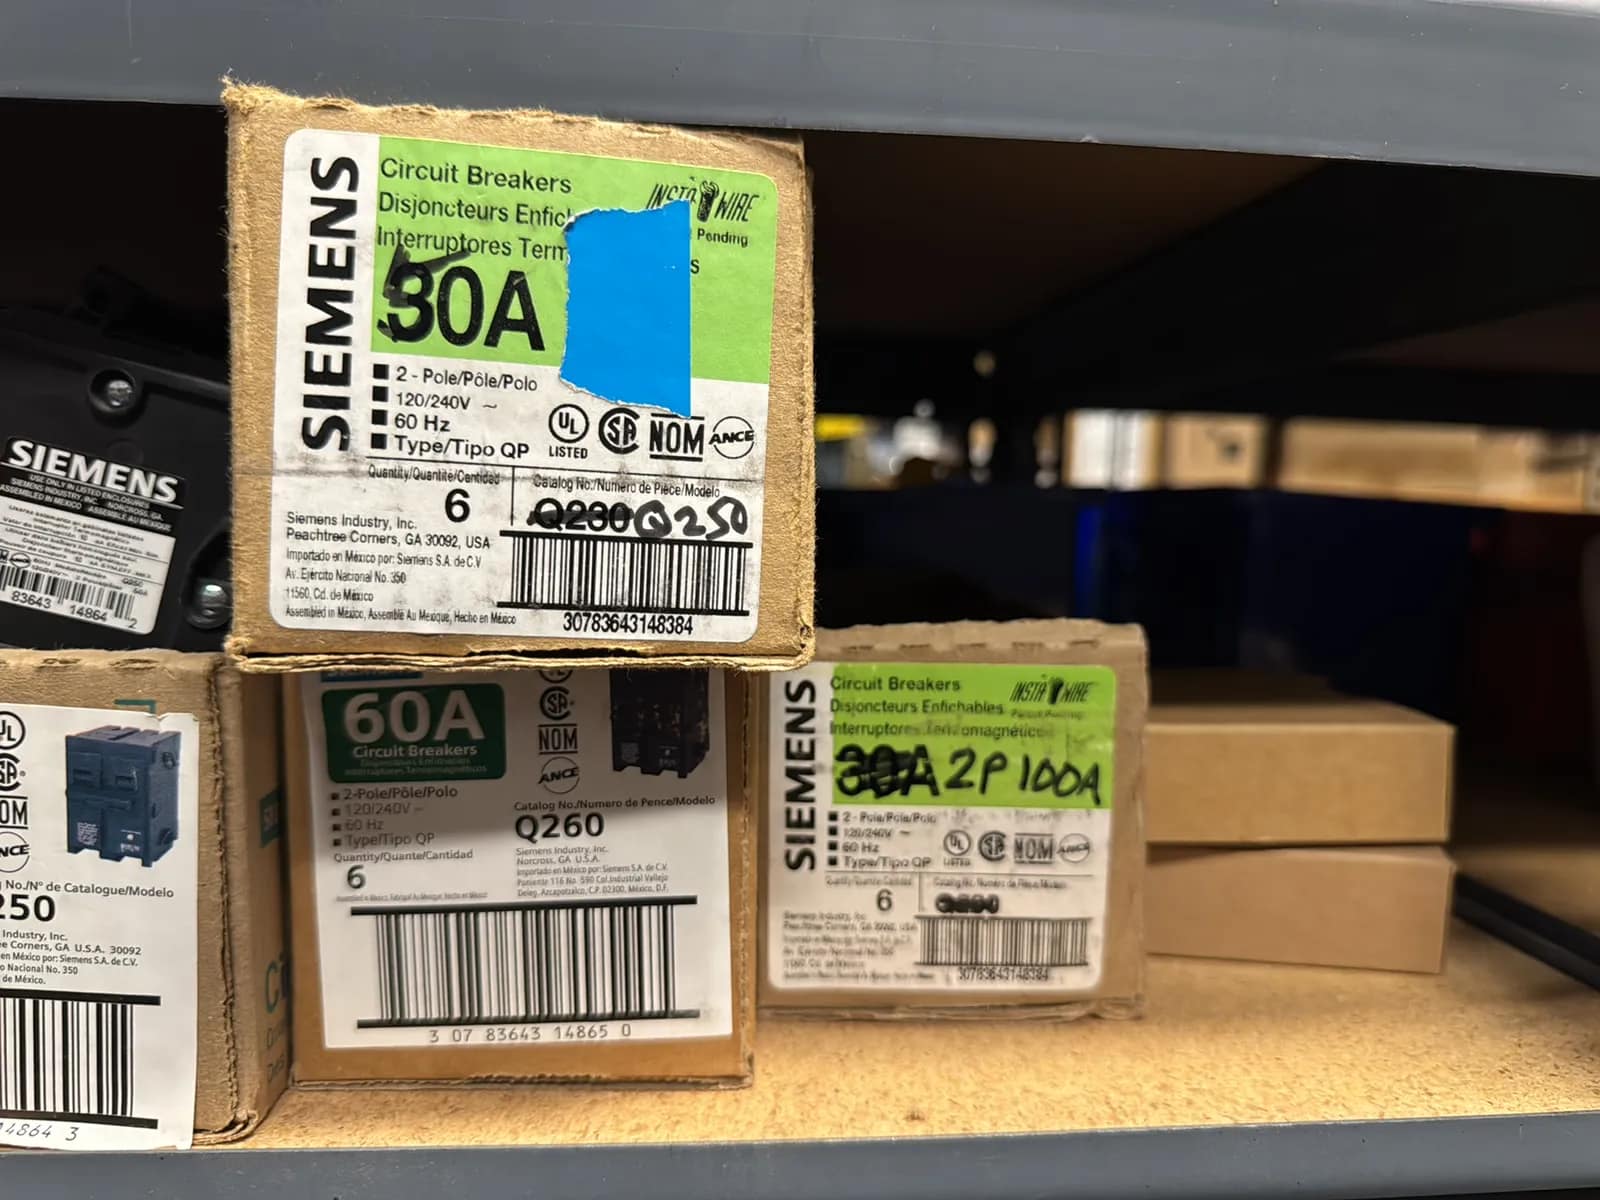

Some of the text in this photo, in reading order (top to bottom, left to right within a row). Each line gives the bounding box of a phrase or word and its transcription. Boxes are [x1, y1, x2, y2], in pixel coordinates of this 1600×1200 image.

[380, 158, 572, 194] Circuit Breakers
[379, 191, 509, 221] Disjoncteurs
[714, 191, 759, 222] WIRE
[377, 226, 512, 257] Interruptores
[697, 228, 748, 248] Pending
[301, 156, 359, 450] SIEMENS
[396, 366, 537, 391] 2 Pole/Pôle/Polo
[397, 392, 470, 410] 120/240V
[395, 414, 450, 432] 60 Hz
[650, 420, 704, 455] NOM
[709, 430, 754, 446] ANCE
[395, 435, 529, 460] Type/Tipo QP
[549, 446, 588, 459] LISTED
[9, 440, 178, 503] SIEMENS
[0, 484, 44, 500] ASSEMBLED
[11, 478, 44, 491] SIEMENS
[533, 474, 573, 492] Catalog
[639, 481, 651, 494] de
[445, 488, 470, 523] 6
[287, 512, 417, 531] Siemens Industry, Inc.
[634, 495, 747, 541] Q250
[286, 527, 490, 549] Peachtree Corners, GA 30092, USA
[332, 552, 342, 562] en
[397, 552, 433, 566] Siemens
[336, 569, 372, 582] Nacional
[391, 571, 406, 583] 350
[330, 589, 341, 600] de
[11, 590, 138, 629] 83643 14864 2
[454, 611, 478, 623] Hecho
[563, 612, 693, 635] 30783643148384
[830, 676, 961, 692] Circuit Breakers
[1009, 681, 1045, 702] INSTA
[344, 689, 486, 744] 60A
[829, 699, 1004, 716] Disjoncteurs Enfichables
[539, 726, 578, 751] NOM
[352, 743, 478, 759] Circuit Breakers
[538, 767, 579, 784] ANCE
[785, 679, 816, 870] SIEMENS
[945, 747, 1101, 805] 2P 100A
[514, 798, 638, 811] Catalog de
[345, 819, 384, 831] 60 Hz
[515, 812, 604, 844] Q260
[416, 832, 435, 845] QP
[842, 841, 879, 853] 60 Hz
[516, 847, 554, 856] Siemens
[593, 845, 608, 854] Inc.
[1014, 837, 1053, 860] NOM
[558, 856, 571, 864] GA
[575, 855, 600, 863] U.S.A.
[911, 857, 931, 867] QP
[346, 864, 366, 889] 6
[46, 881, 174, 898] de Catalogue/Modelo
[876, 889, 892, 912] 6
[3, 930, 68, 942] Industry, Inc.
[10, 941, 52, 952] Corners,
[55, 943, 69, 952] GA
[74, 944, 105, 954] U.S.A.
[110, 945, 141, 956] 30092
[12, 952, 41, 963] México
[60, 954, 92, 965] Siemens
[111, 957, 121, 966] de
[123, 958, 139, 967] C.V.
[7, 964, 44, 974] Nacional
[47, 966, 60, 975] No.
[62, 966, 78, 976] 350
[2, 974, 46, 985] de México.
[429, 1023, 631, 1043] 3 07 83643 14865 0
[65, 1126, 80, 1141] 3
